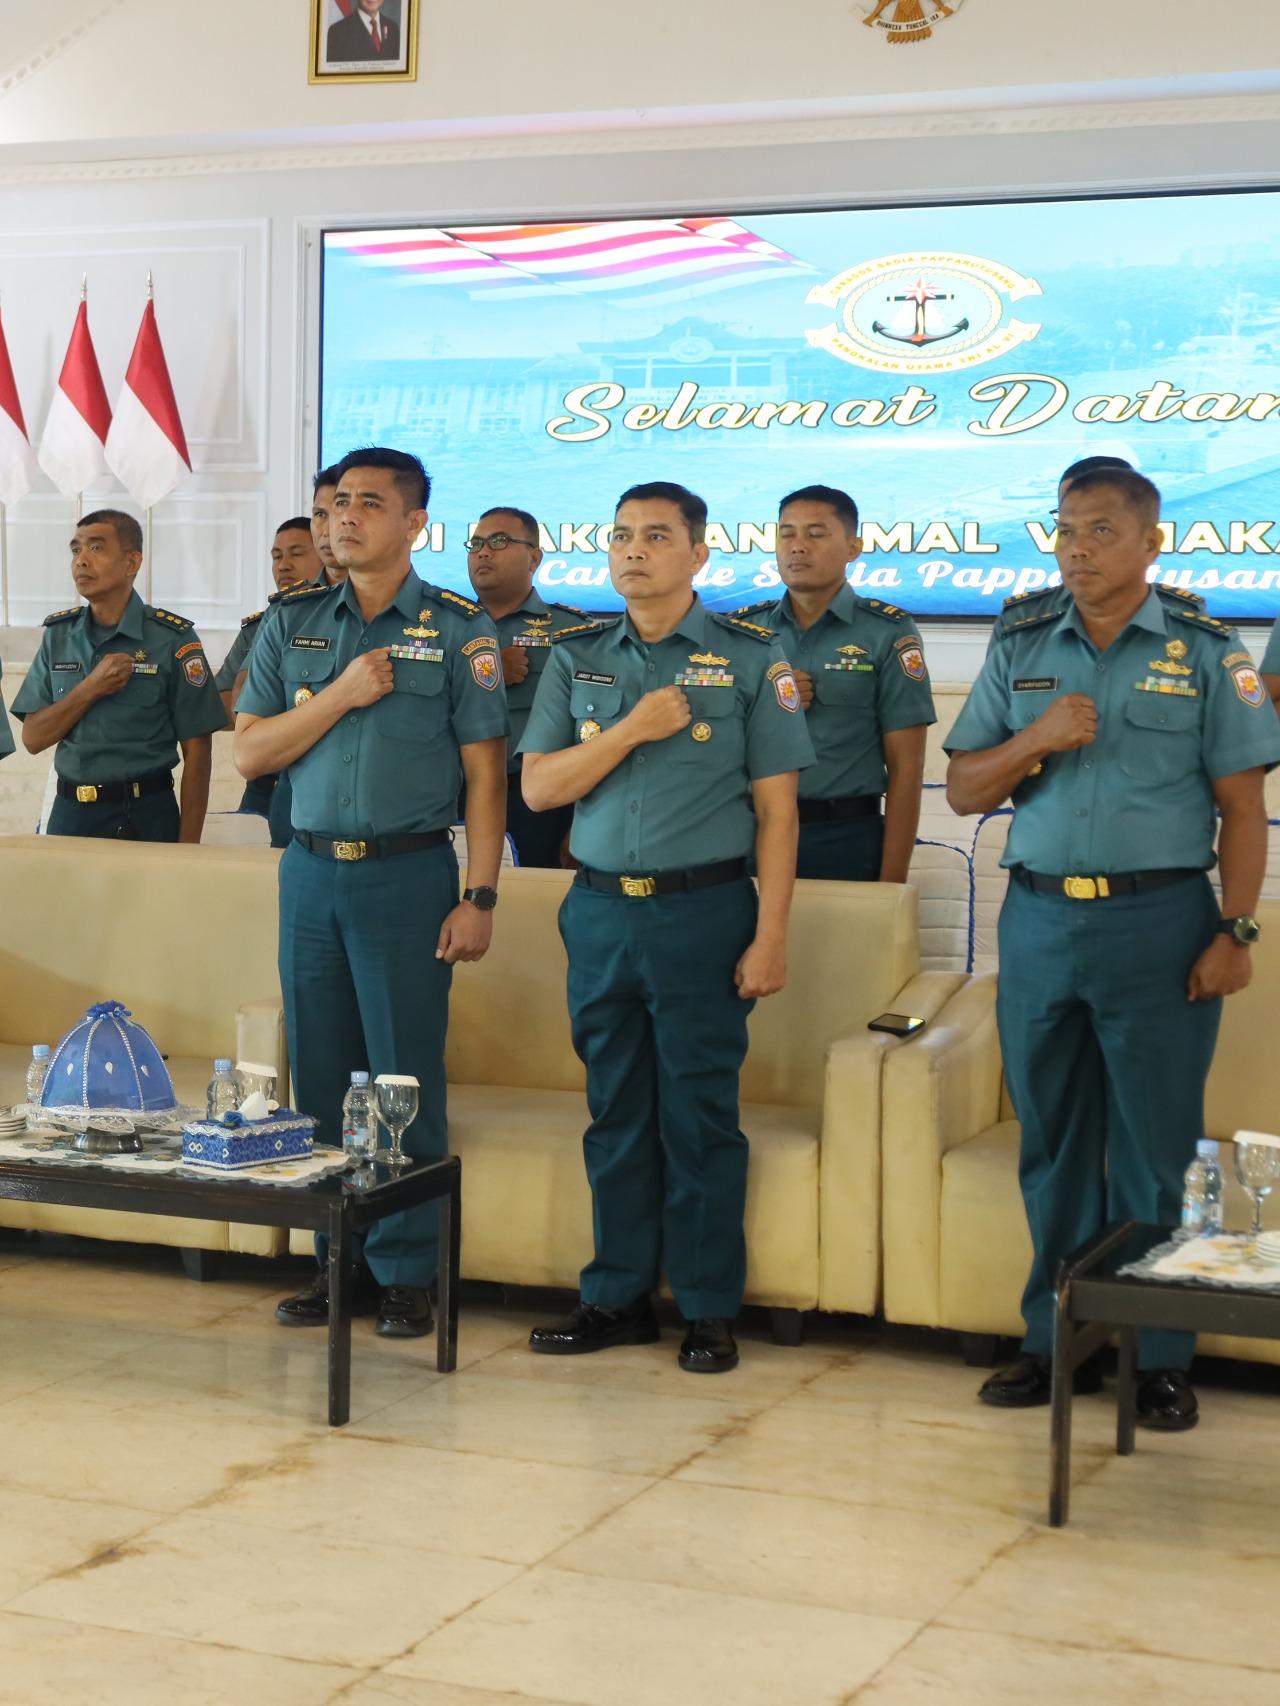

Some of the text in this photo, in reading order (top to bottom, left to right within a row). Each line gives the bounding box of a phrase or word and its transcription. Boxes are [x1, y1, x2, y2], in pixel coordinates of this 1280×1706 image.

[877, 256, 915, 269] SADIA
[831, 333, 1014, 370] PANGKALAN UTAMA TNI AL VI
[546, 381, 936, 442] Selamat
